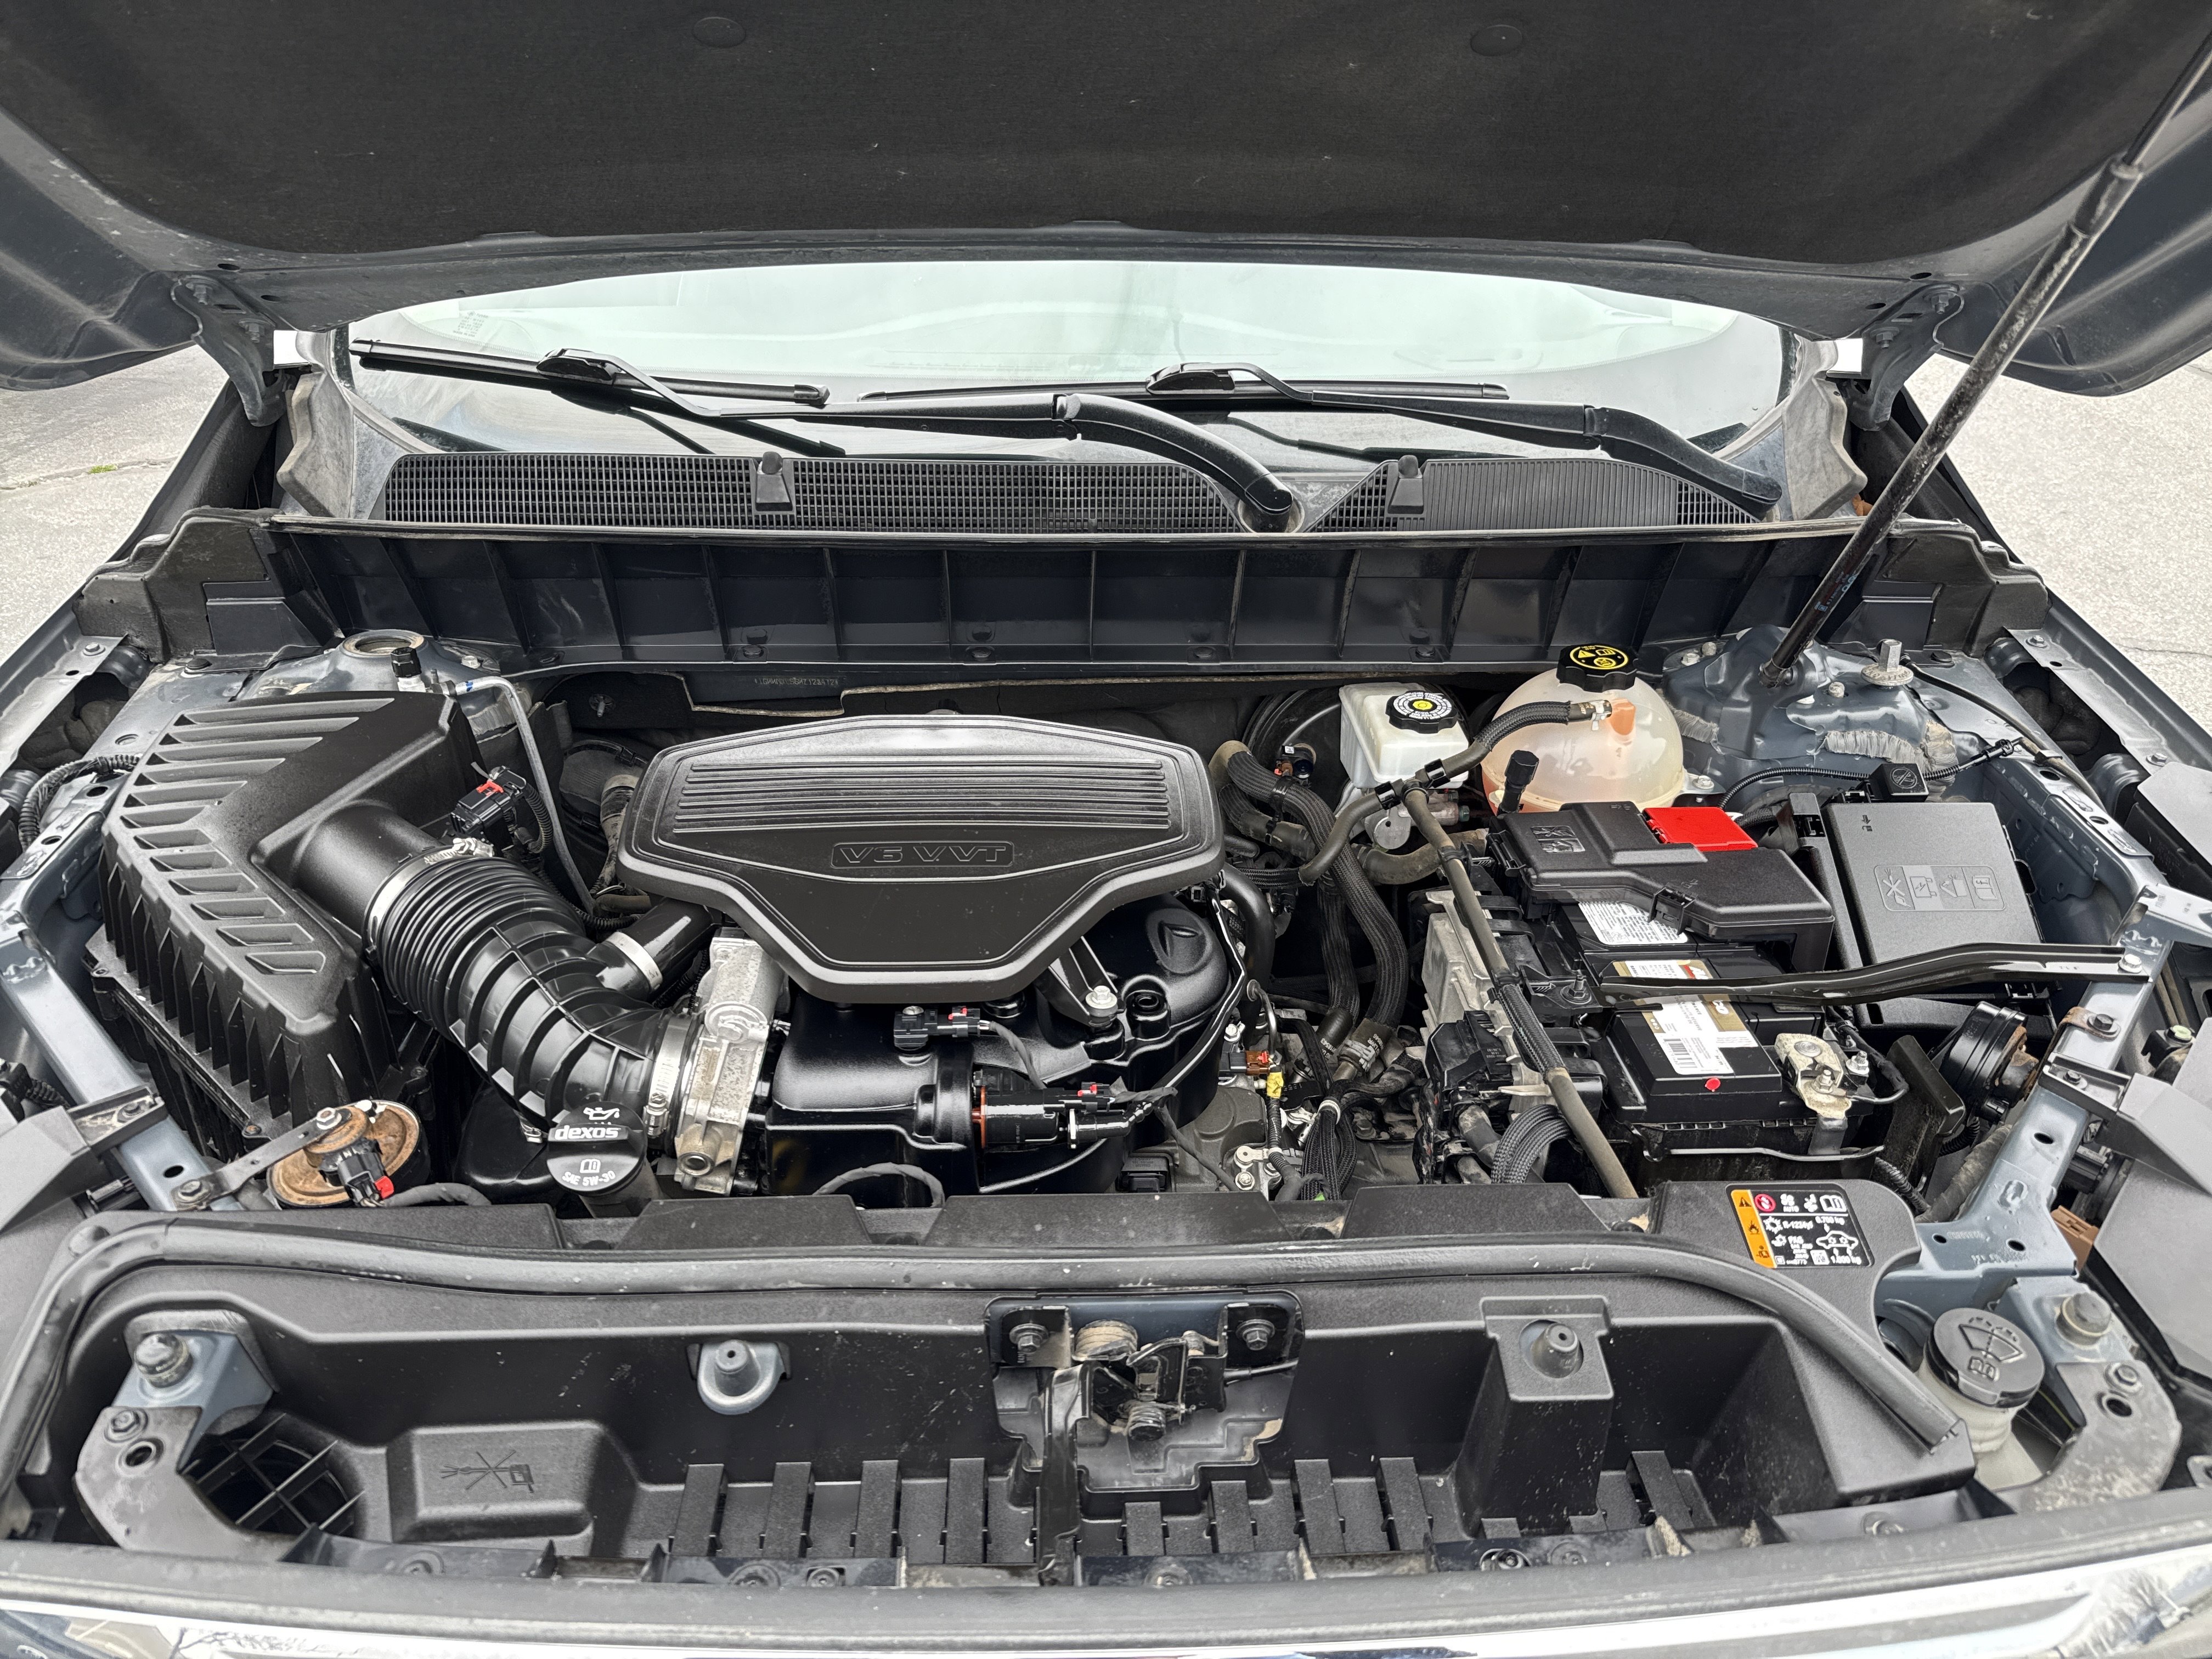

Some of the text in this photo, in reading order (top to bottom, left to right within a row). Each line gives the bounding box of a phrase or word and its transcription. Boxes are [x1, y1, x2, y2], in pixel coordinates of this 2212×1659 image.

[840, 845, 1007, 864] V6 VVT
[555, 1125, 619, 1139] dexos
[562, 1170, 616, 1186] SAE 5W-30
